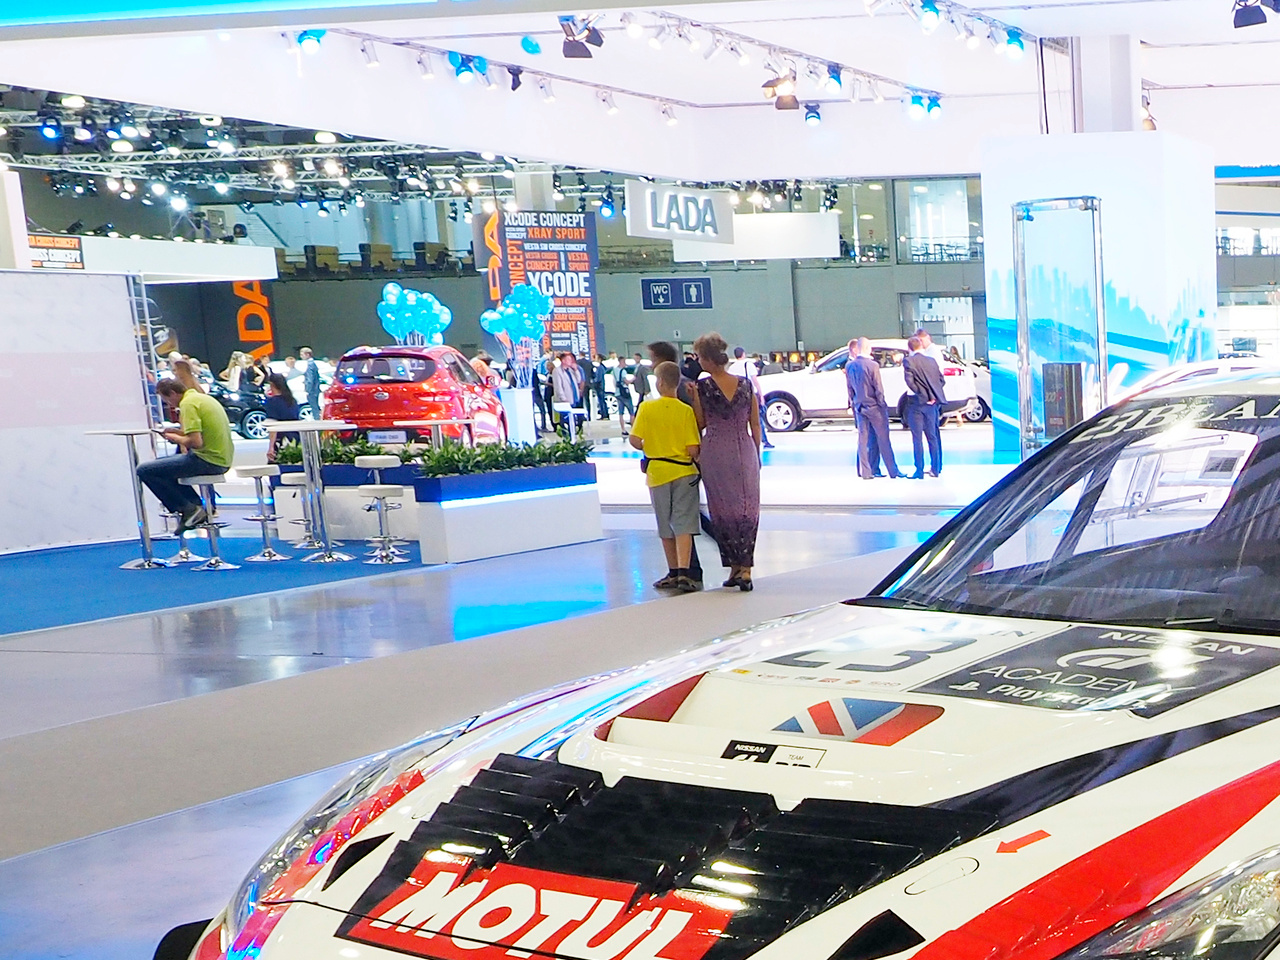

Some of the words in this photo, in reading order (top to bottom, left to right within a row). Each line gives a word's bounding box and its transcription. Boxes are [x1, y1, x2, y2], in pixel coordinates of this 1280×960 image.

[646, 188, 719, 235] LADA
[504, 212, 538, 227] XCODE
[539, 213, 586, 228] CONCEPT
[527, 227, 553, 239] XRAY
[555, 228, 586, 239] SPORT
[567, 252, 589, 260] VESTA
[506, 239, 527, 289] ONCEPT
[525, 261, 559, 270] CONCEPT
[568, 262, 590, 271] SPORT
[526, 271, 591, 297] XCODE
[652, 285, 668, 294] WC
[552, 321, 577, 332] SPORT
[734, 743, 767, 754] NISSAN
